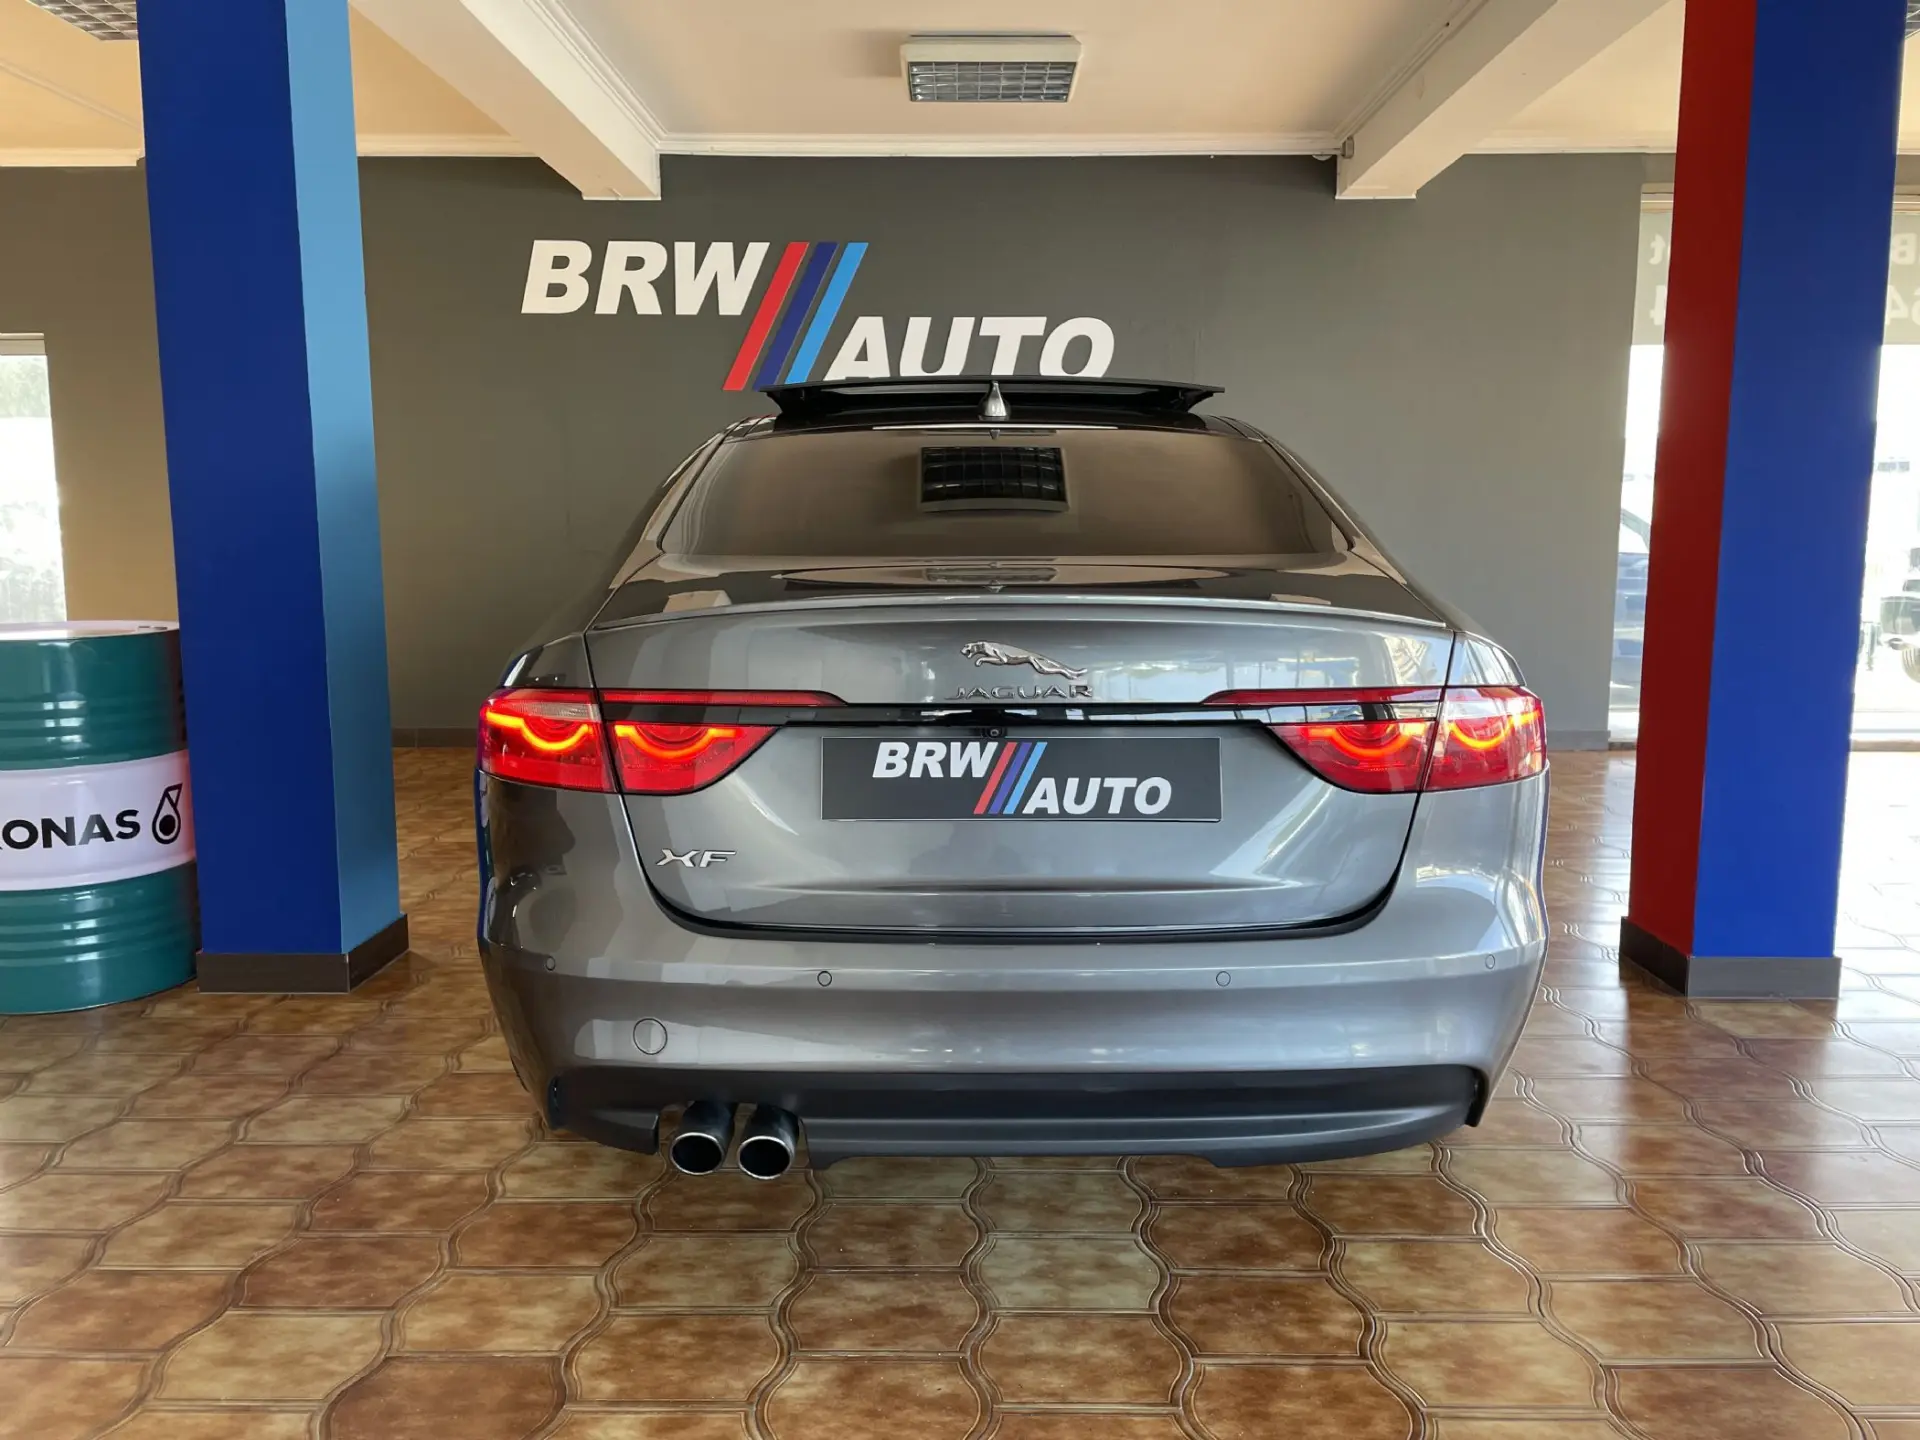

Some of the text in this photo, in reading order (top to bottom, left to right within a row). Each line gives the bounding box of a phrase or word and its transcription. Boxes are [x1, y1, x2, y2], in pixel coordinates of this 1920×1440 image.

[520, 239, 771, 316] BRW
[822, 316, 1116, 382] AUTO
[944, 684, 1093, 700] JAGUAR
[872, 741, 999, 779] BRW
[1022, 776, 1173, 815] AUTO
[0, 808, 141, 850] ONAS
[656, 848, 737, 868] XF
